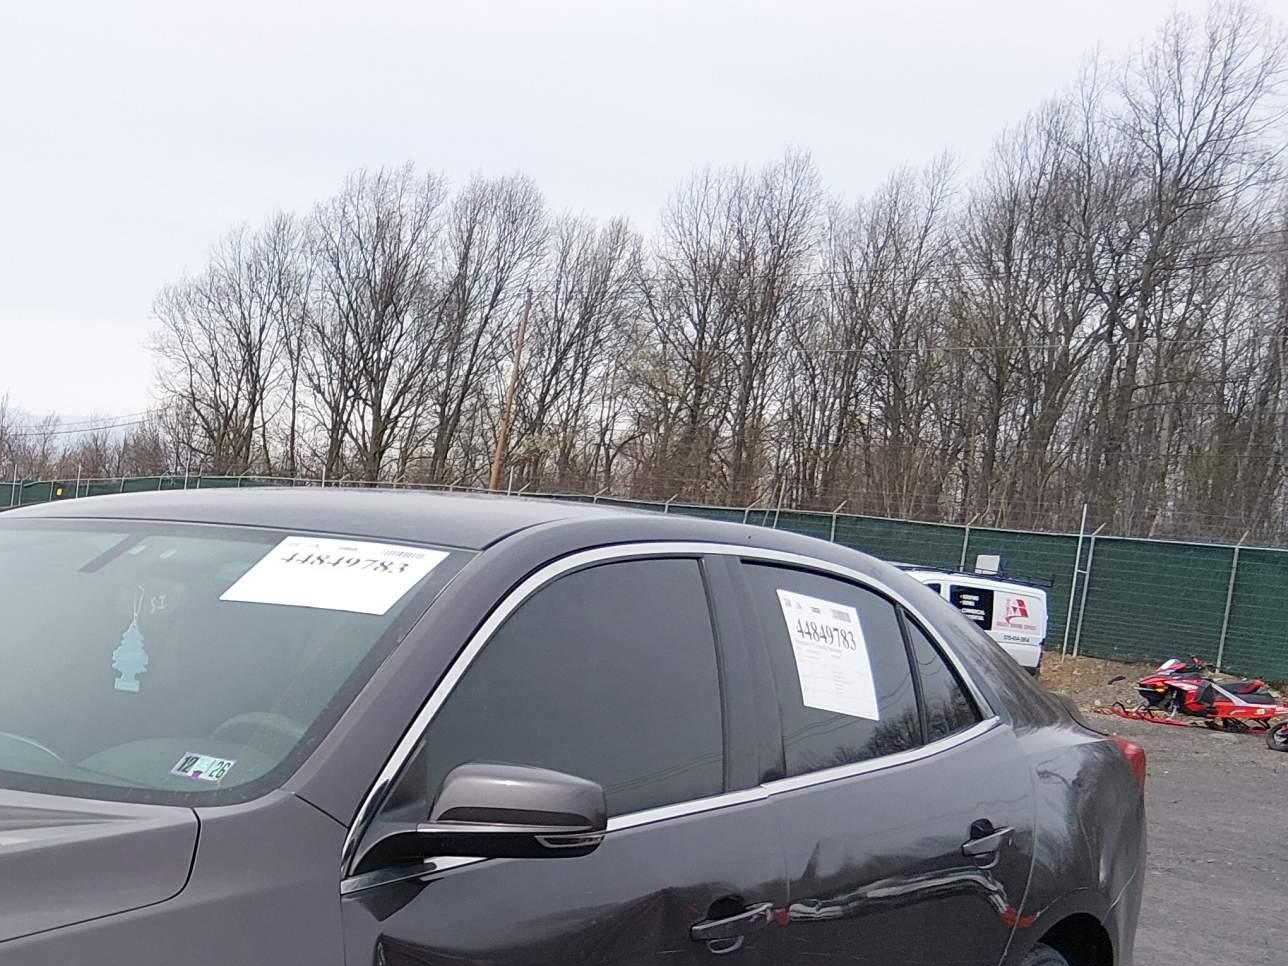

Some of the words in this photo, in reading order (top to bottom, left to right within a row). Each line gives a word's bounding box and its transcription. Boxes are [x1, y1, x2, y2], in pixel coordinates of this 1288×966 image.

[281, 551, 409, 574] 44849783
[796, 618, 857, 651] 44849783
[177, 755, 200, 773] 12
[208, 760, 232, 778] 26
